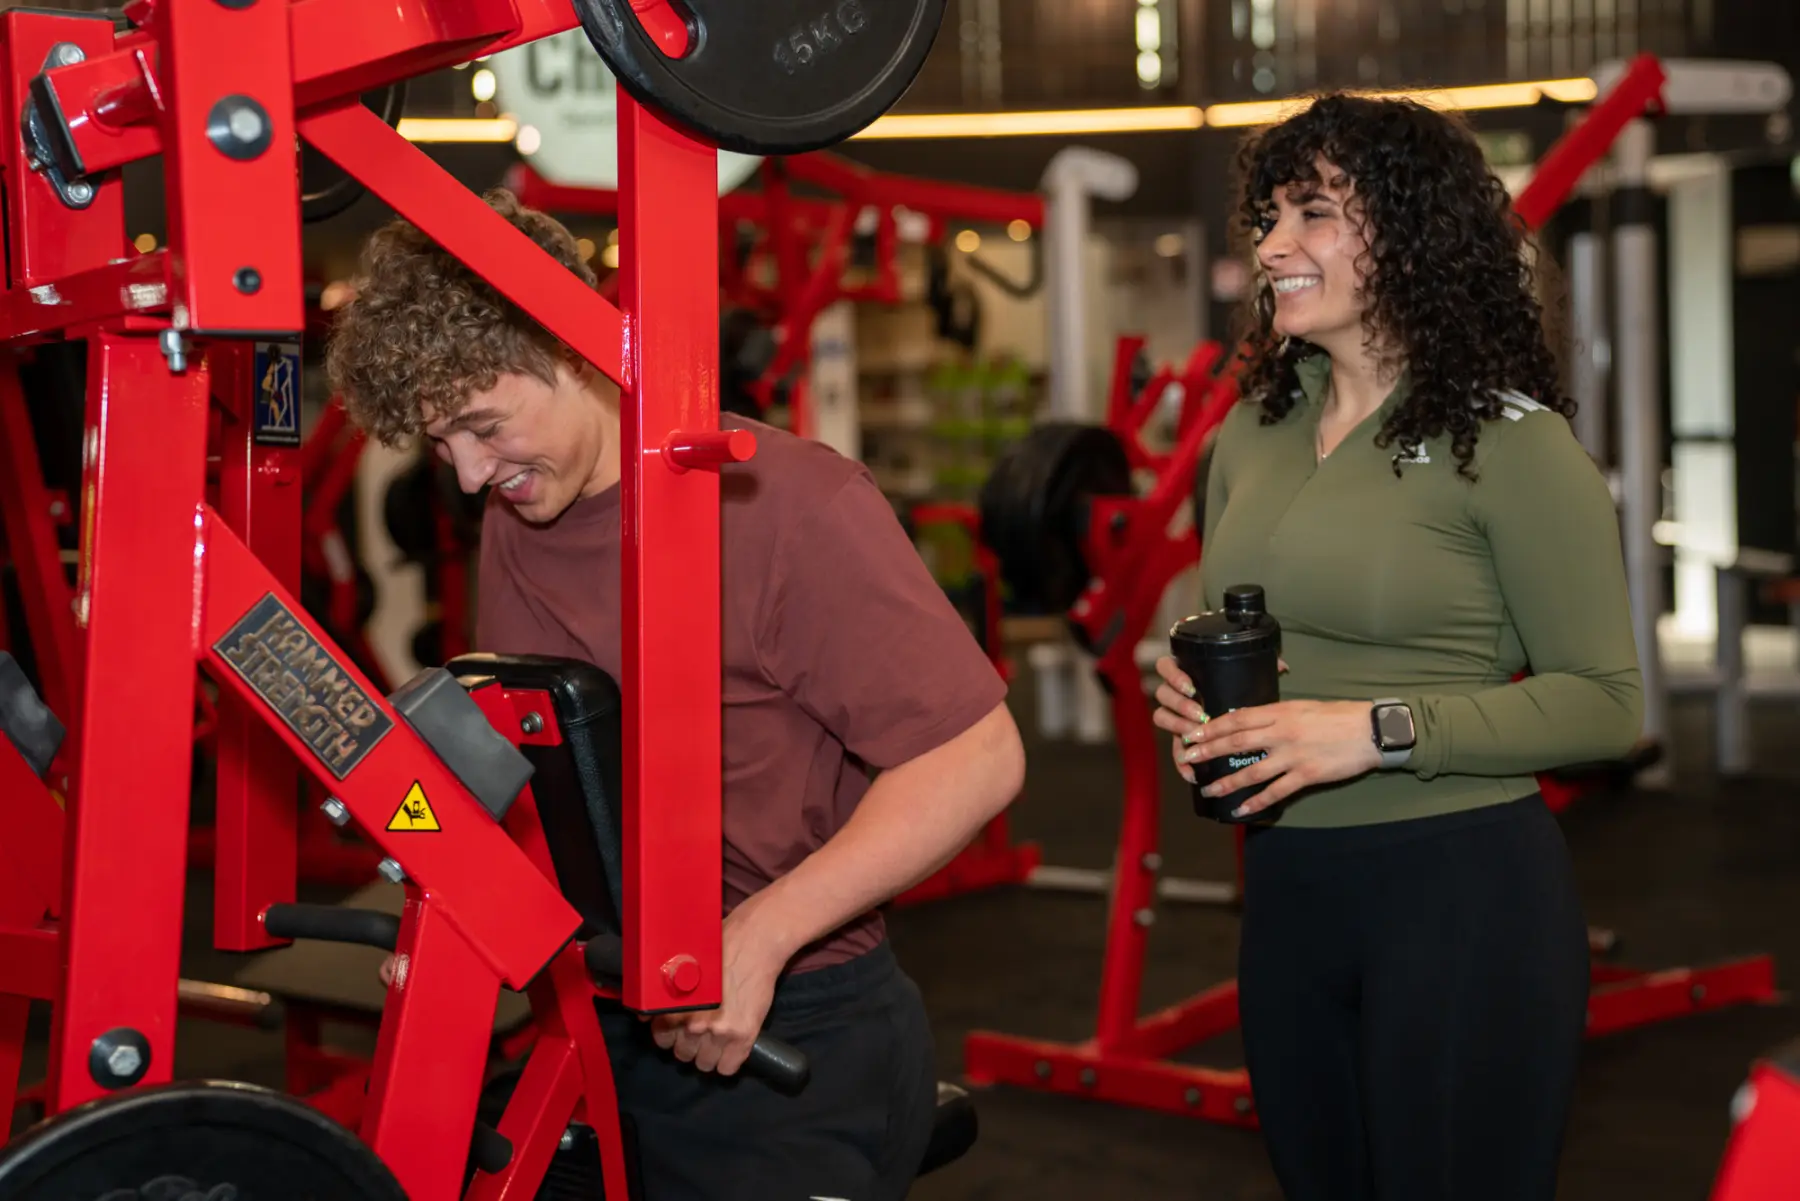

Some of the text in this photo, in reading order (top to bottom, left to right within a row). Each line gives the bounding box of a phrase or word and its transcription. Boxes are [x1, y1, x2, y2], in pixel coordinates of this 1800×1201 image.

[226, 632, 358, 767] STRENGTH
[254, 609, 376, 735] HAMMER
[1228, 755, 1260, 768] Sports
